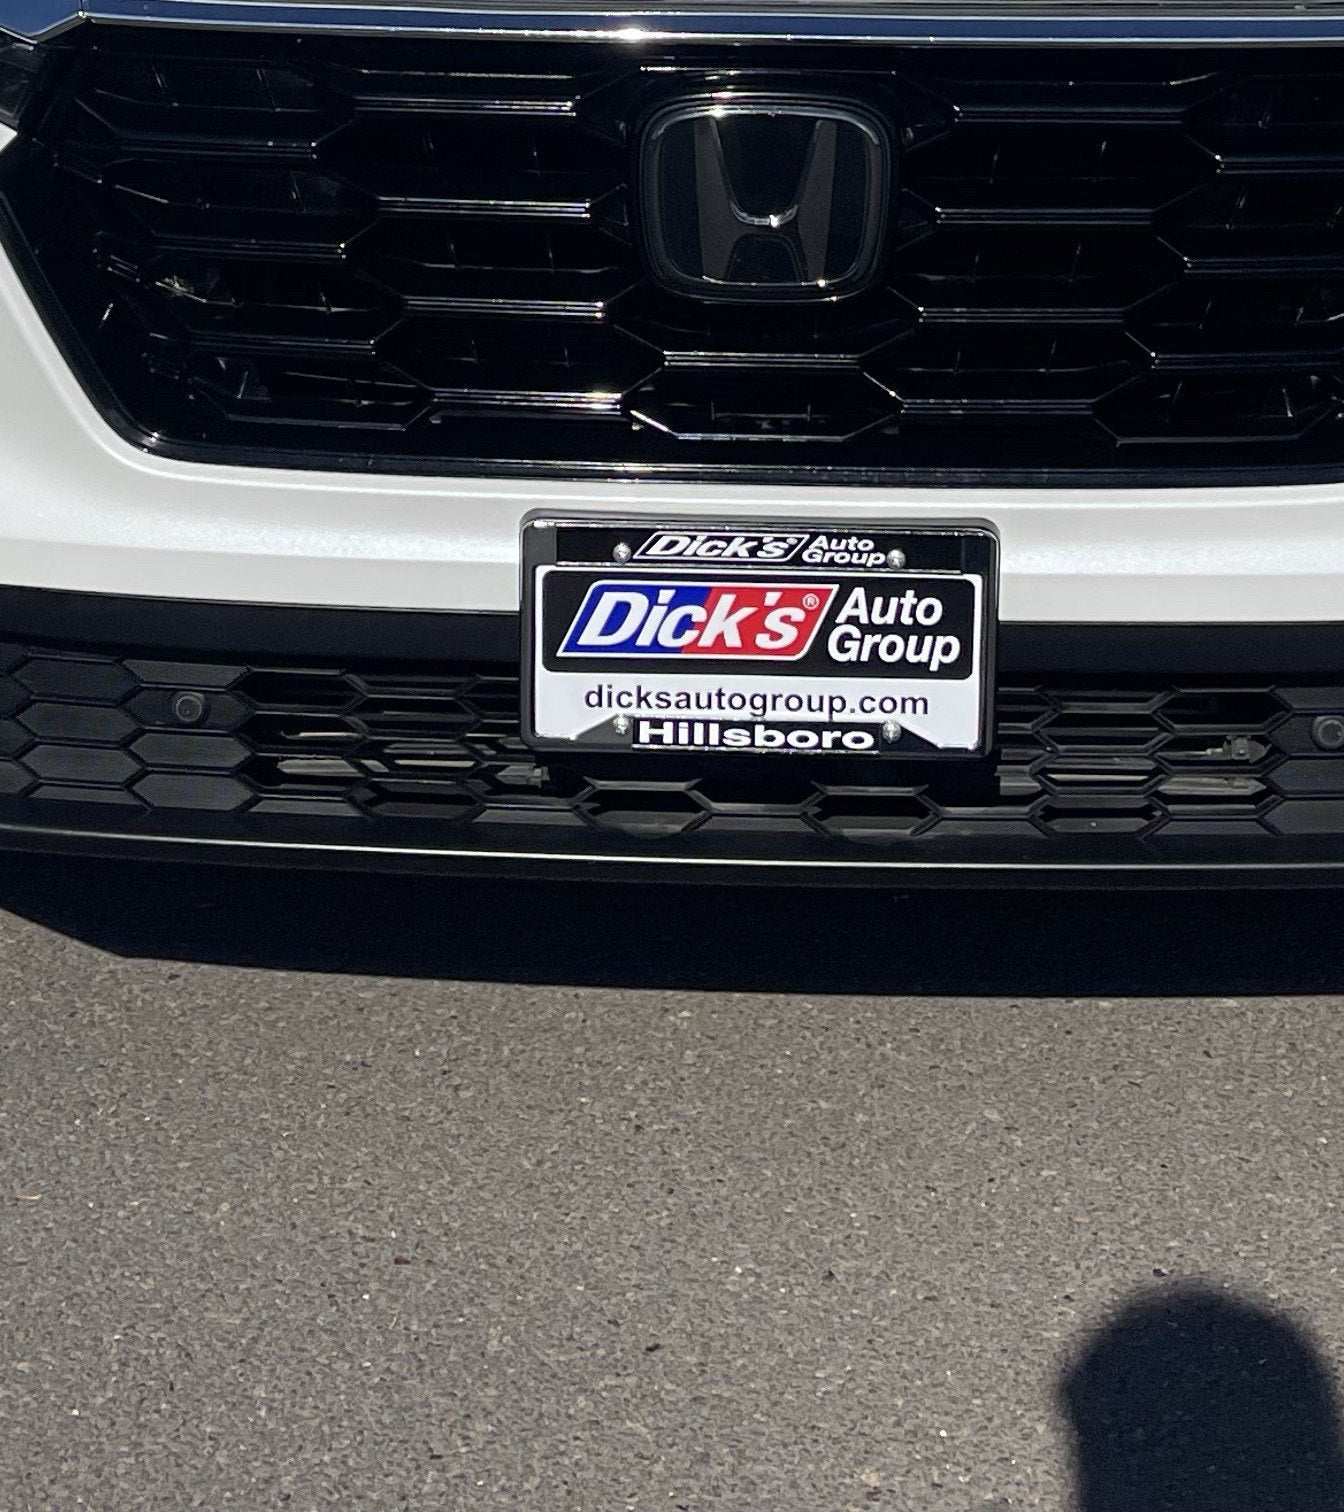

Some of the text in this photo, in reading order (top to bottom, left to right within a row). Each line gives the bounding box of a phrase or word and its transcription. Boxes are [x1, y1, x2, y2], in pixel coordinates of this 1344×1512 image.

[801, 549, 886, 567] Group
[809, 536, 875, 551] Auto
[836, 587, 944, 626] Auto
[827, 626, 961, 672] Group
[584, 684, 929, 721] dicksautogroup.com
[639, 721, 875, 750] Hillsboro
